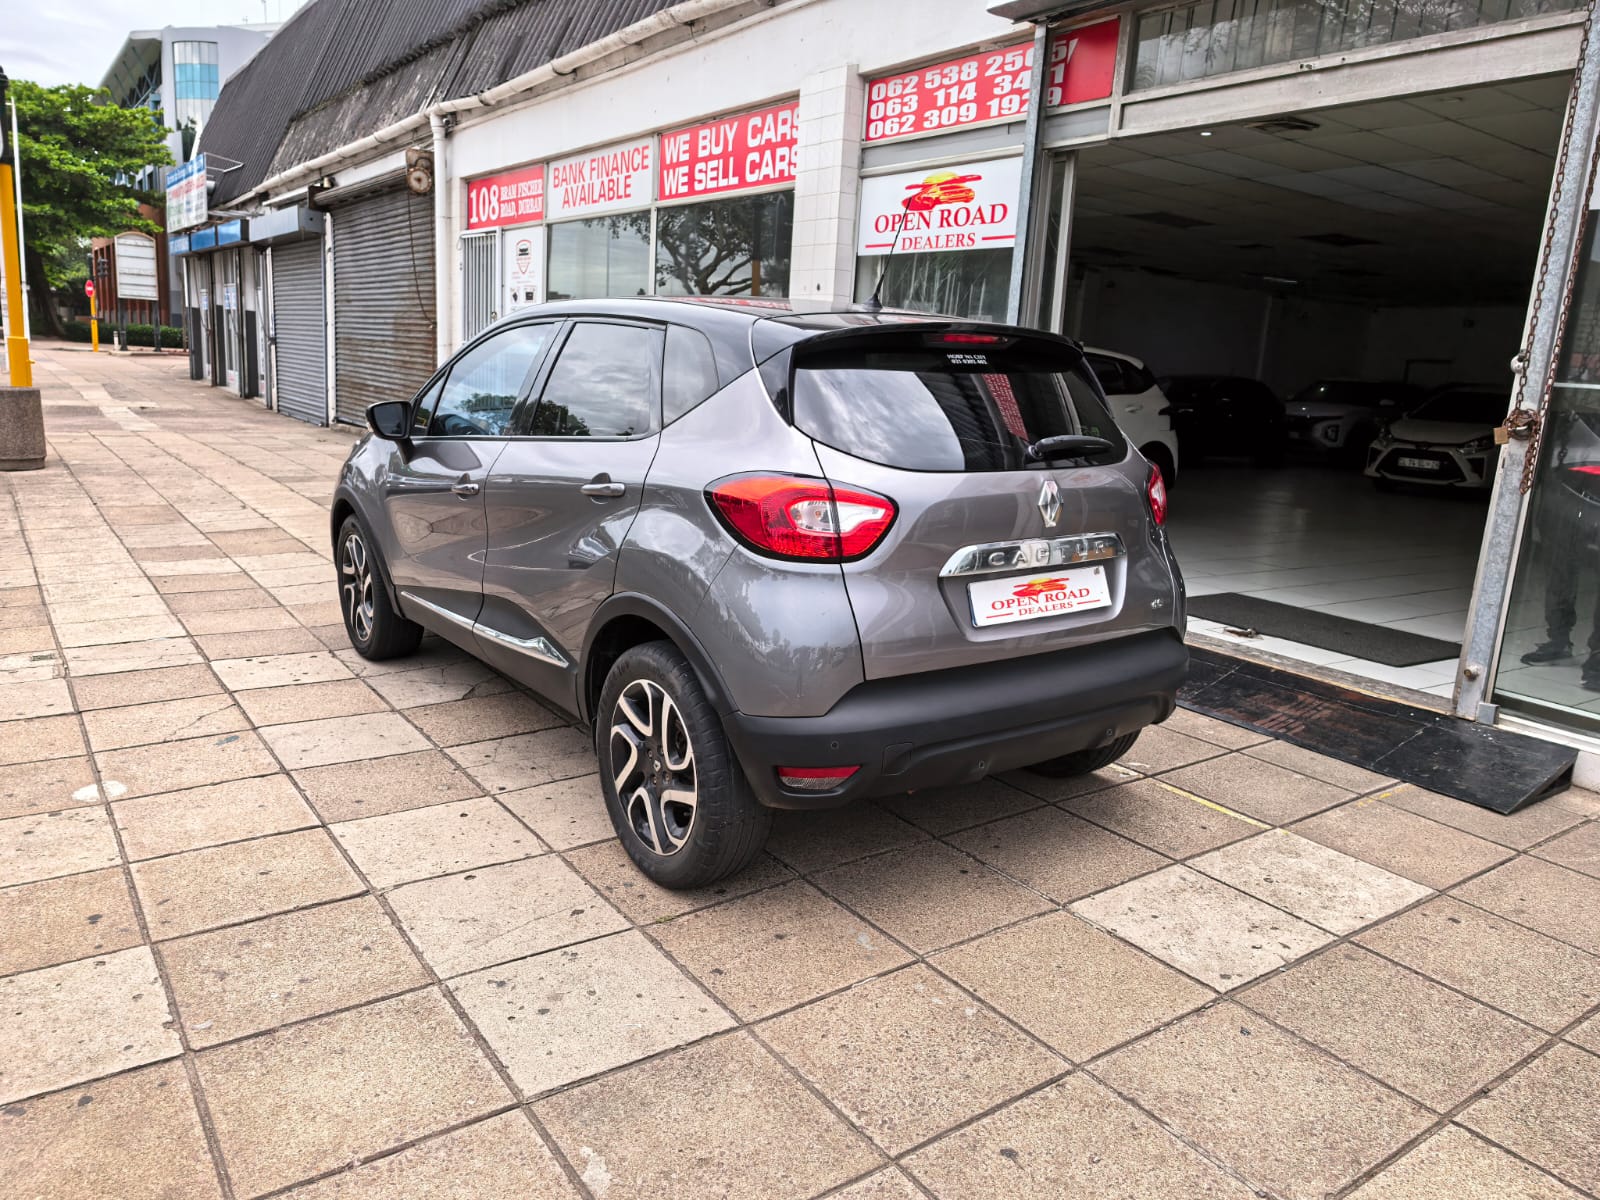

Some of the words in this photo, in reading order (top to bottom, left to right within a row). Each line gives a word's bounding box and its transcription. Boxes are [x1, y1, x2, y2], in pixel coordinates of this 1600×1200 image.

[871, 75, 919, 101] 062
[925, 61, 978, 89] 538
[870, 94, 919, 120] 063
[934, 82, 976, 107] 114
[868, 114, 916, 139] 062
[923, 102, 977, 128] 309
[664, 133, 690, 165] WE
[698, 121, 739, 158] BUY
[553, 160, 586, 189] BANK
[589, 144, 650, 181] FINANCE
[663, 165, 689, 196] WE
[694, 156, 739, 191] SELL
[470, 184, 500, 224] 108
[562, 174, 632, 209] AVAILABLE
[874, 211, 933, 234] OPEN
[938, 202, 1009, 229] ROAD
[901, 232, 976, 251] DEALERS
[988, 540, 1107, 566] CAPTUR
[991, 596, 1040, 611] OPEN
[1045, 587, 1090, 604] ROAD
[1018, 601, 1074, 616] DEALERS
